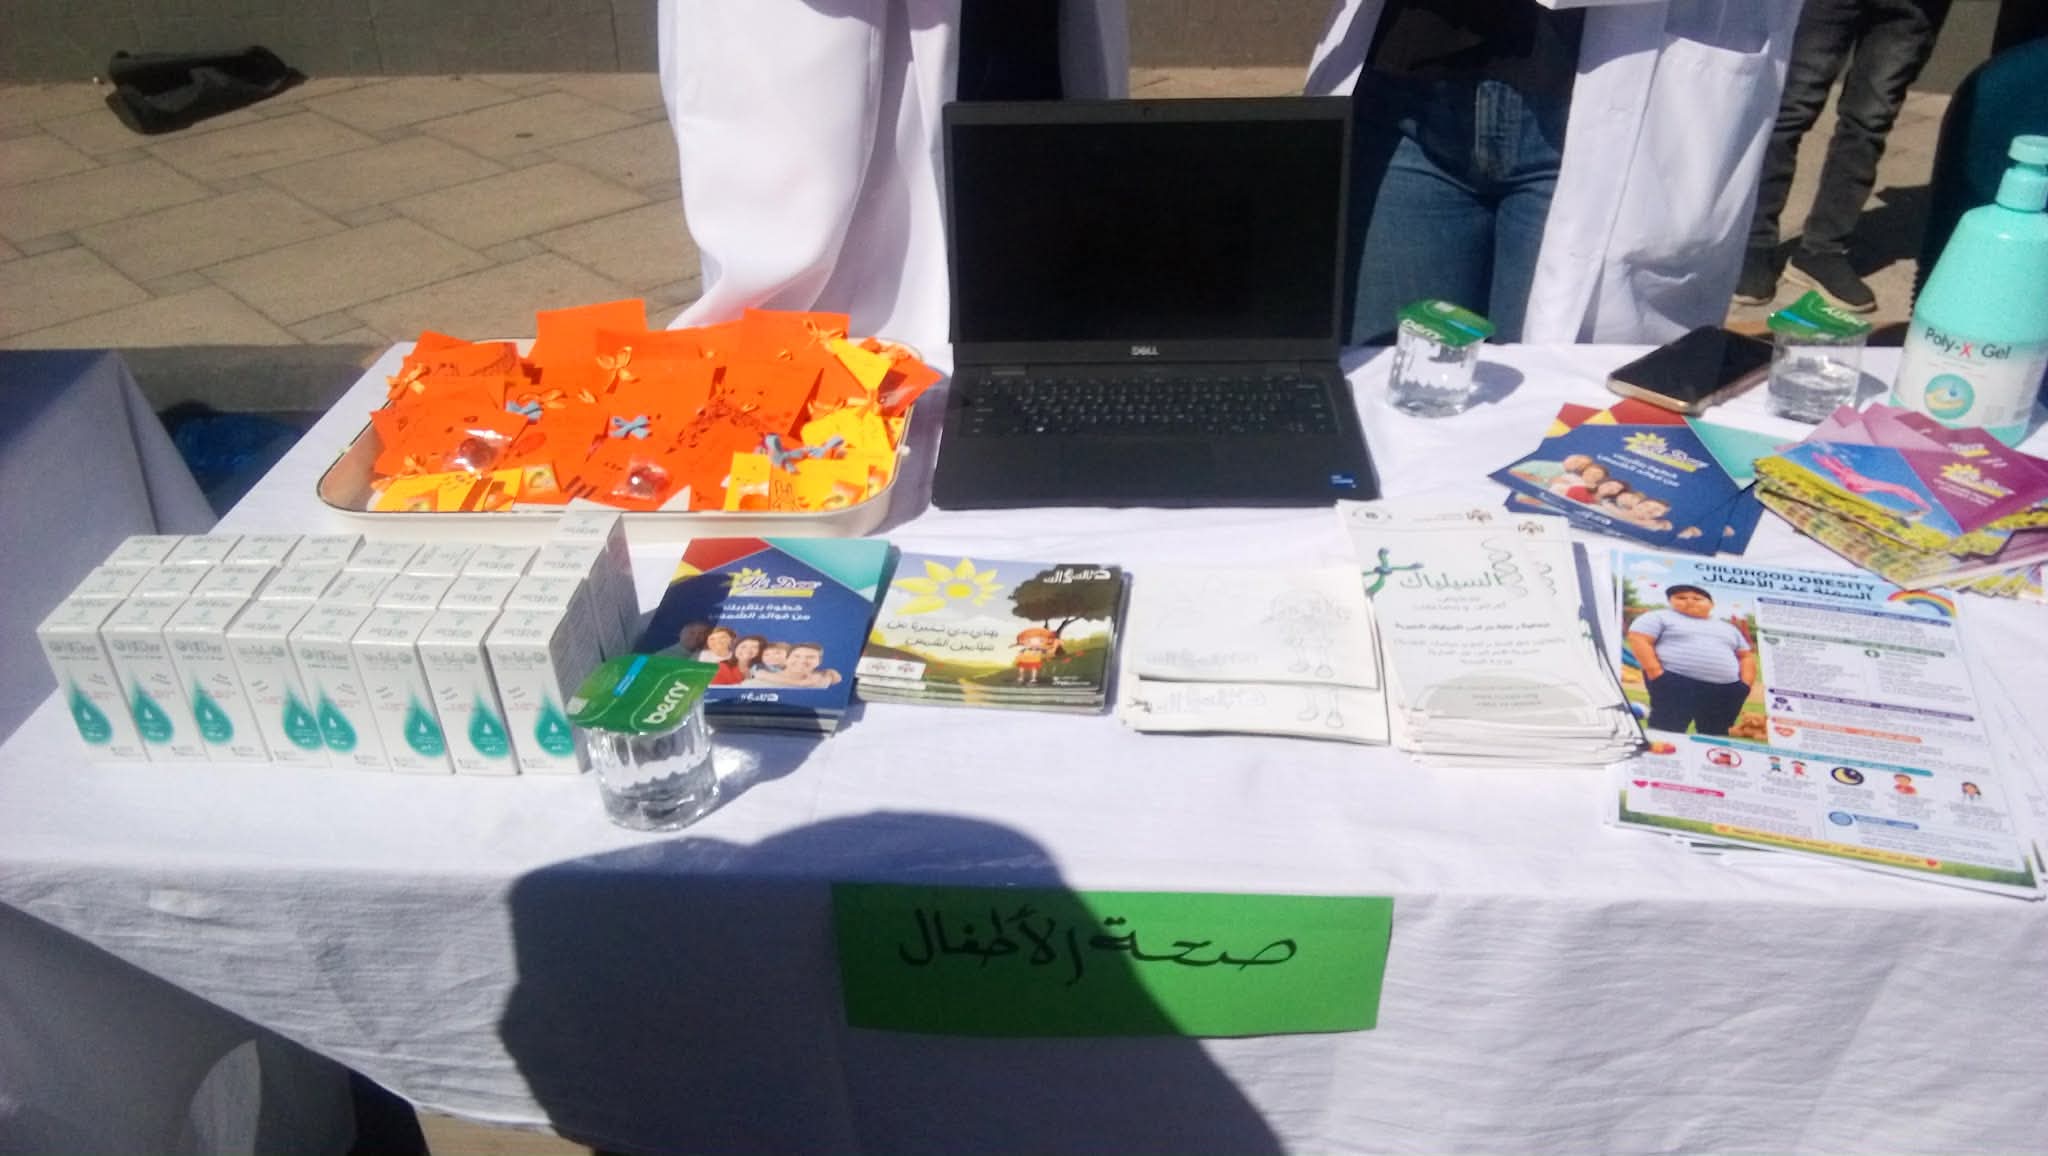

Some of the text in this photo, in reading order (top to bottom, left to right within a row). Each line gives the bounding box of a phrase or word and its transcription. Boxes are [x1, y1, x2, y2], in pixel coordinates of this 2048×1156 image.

[1131, 345, 1160, 356] DELL
[1981, 342, 2012, 359] Gel
[1399, 571, 1504, 590] السيلياك
[1694, 562, 1875, 592] CHILDHOOD OBESITY
[1702, 574, 1873, 601] السمنة عند الأطفال
[641, 680, 690, 725] berry
[1090, 915, 1298, 972] صحة
